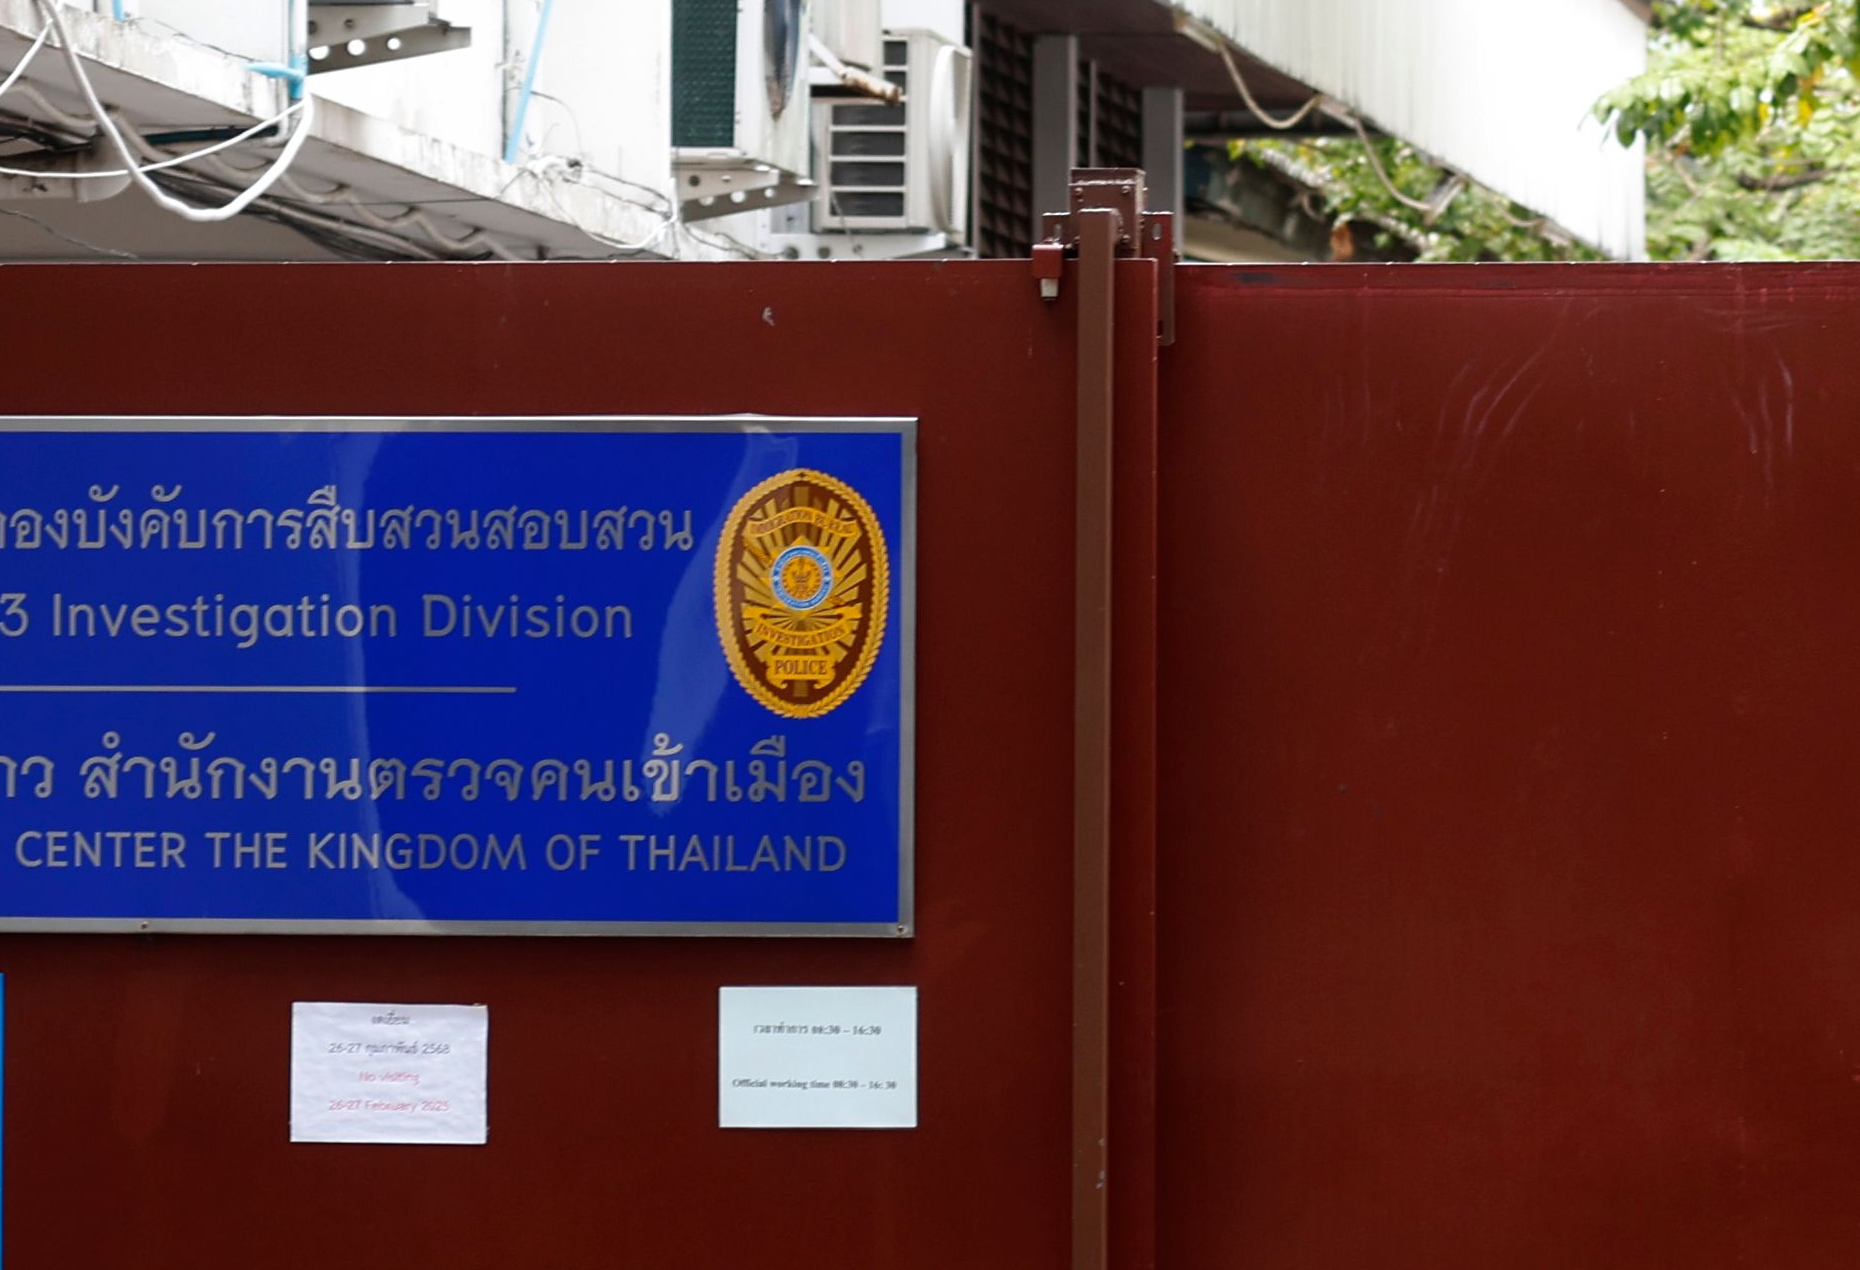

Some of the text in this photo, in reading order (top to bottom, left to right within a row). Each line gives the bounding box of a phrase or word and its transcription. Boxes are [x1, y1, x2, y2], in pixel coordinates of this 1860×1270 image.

[53, 593, 396, 649] Investigation
[421, 594, 632, 638] Division
[755, 622, 847, 648] INVESTIGATION
[773, 659, 828, 676] POLICE
[79, 730, 865, 803] สำนักงานตรวจคนเข้าเมือง
[15, 830, 186, 868] CENTER
[204, 831, 288, 869] THE
[308, 832, 526, 870] KINGDOM
[545, 833, 601, 871] OF
[619, 834, 845, 872] THAILAND
[732, 1078, 768, 1089] Official
[769, 1079, 808, 1091] working
